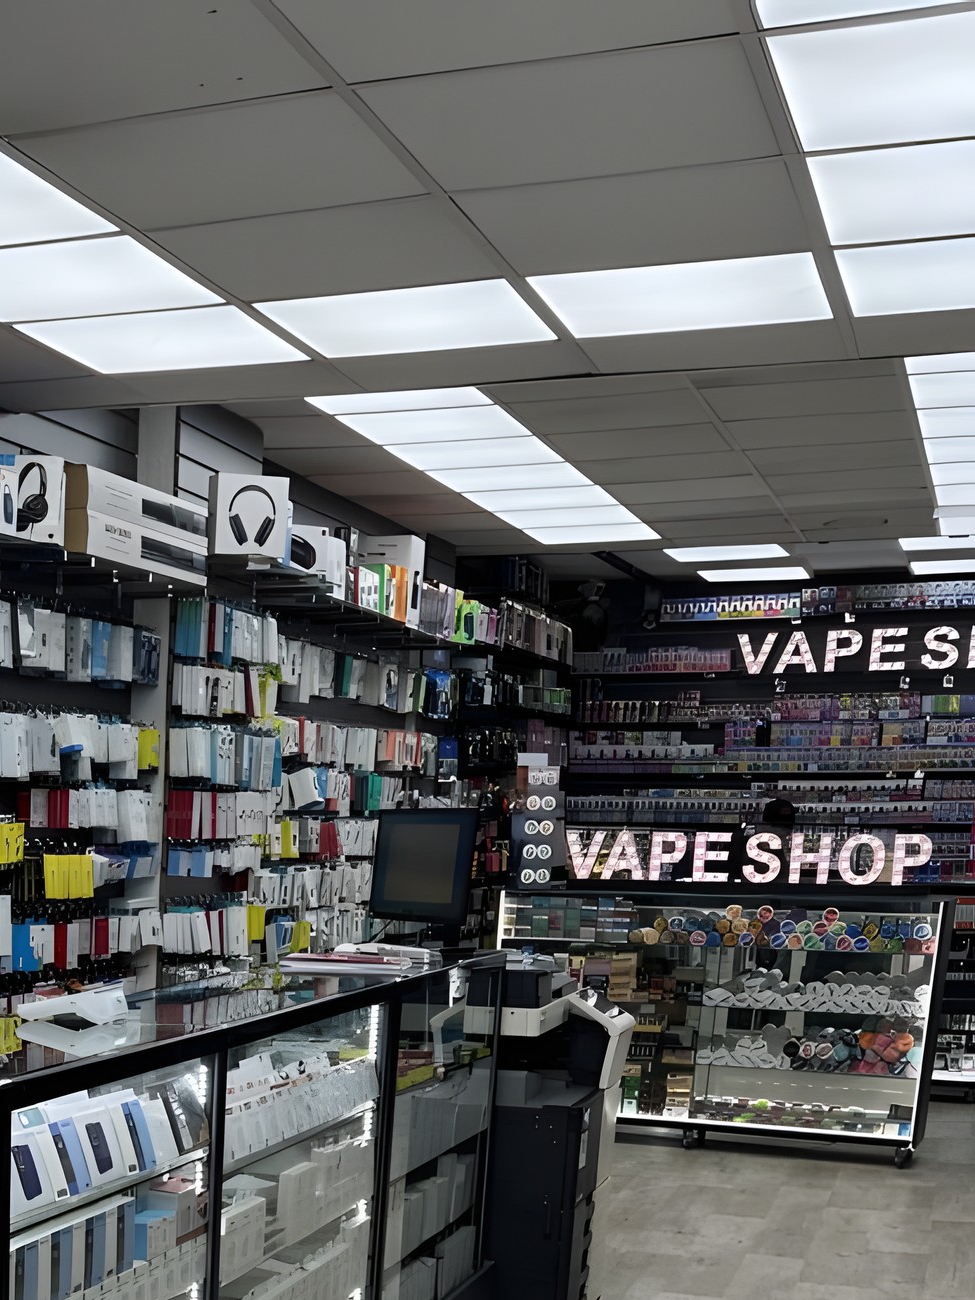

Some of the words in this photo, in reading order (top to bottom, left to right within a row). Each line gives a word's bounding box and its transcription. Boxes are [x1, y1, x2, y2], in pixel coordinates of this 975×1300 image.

[736, 626, 909, 676] VAPE
[920, 624, 975, 671] S
[565, 829, 734, 881] VAPE
[741, 831, 934, 887] SHOP
